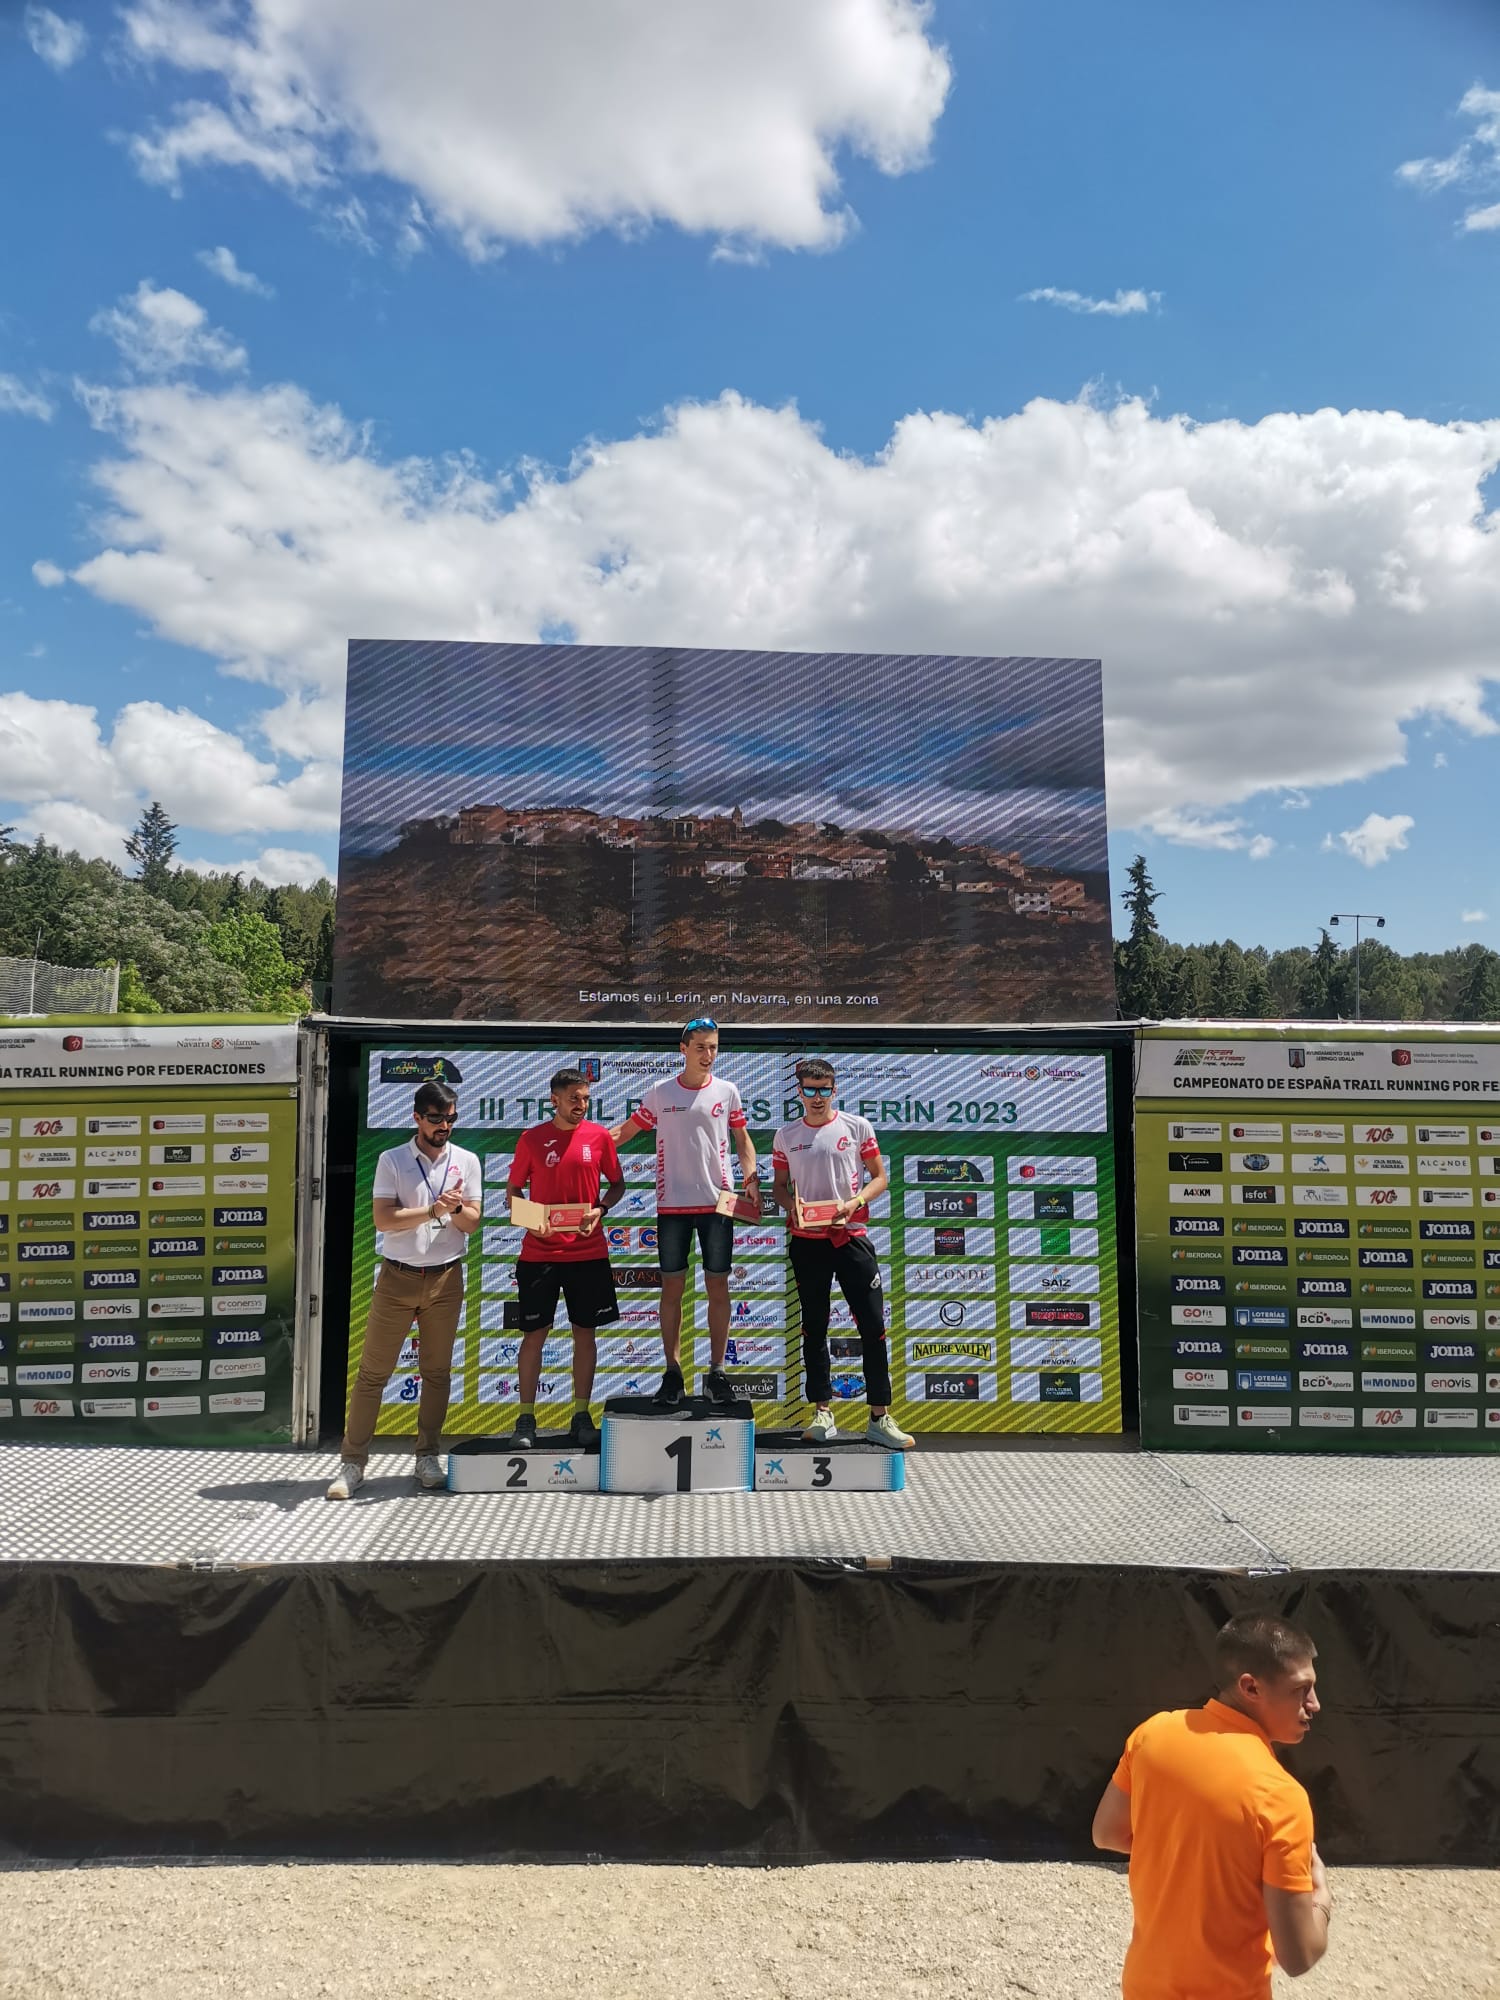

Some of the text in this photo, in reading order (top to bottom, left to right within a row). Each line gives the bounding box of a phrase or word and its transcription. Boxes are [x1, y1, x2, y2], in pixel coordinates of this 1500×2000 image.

[579, 990, 640, 1003] Estamos
[709, 994, 727, 1004] en
[731, 992, 790, 1006] Navarra,
[794, 995, 812, 1005] en
[816, 995, 842, 1005] una
[845, 995, 879, 1005] zona
[14, 1067, 56, 1078] TRAIL
[59, 1066, 124, 1078] RUNNING
[127, 1065, 156, 1077] POR
[158, 1063, 266, 1076] FEDERACIONES
[980, 1068, 1022, 1078] Navarra
[1173, 1076, 1500, 1093] CAMPEONATO DE ESPAÑA TRAIL RUNNING POR FE
[479, 1098, 504, 1121] III
[515, 1098, 614, 1121] TRIL
[946, 1101, 1018, 1124] 2023
[33, 1219, 73, 1227] IBERDROLA
[165, 1215, 203, 1223] IBERDROLA
[915, 1269, 989, 1280] ALCONDE
[34, 1278, 73, 1286] IBERDROLA
[1042, 1279, 1071, 1287] SAIZ
[28, 1307, 73, 1317] MONDO
[1252, 1310, 1286, 1318] LOTERÍAS
[1300, 1315, 1324, 1324] BCD
[1371, 1315, 1414, 1324] MONDO
[34, 1340, 73, 1348] IBERDROLA
[915, 1343, 990, 1358] NATURE VALLEY
[26, 1370, 72, 1380] MONDO
[1253, 1374, 1287, 1382] LOTERÍAS
[1302, 1379, 1326, 1388] BCD
[1372, 1378, 1415, 1387] MONDO
[664, 1436, 692, 1492] 1
[506, 1457, 528, 1487] 2
[811, 1456, 833, 1488] 3
[547, 1477, 578, 1485] CaixaBank
[758, 1477, 789, 1485] CaixaBank
